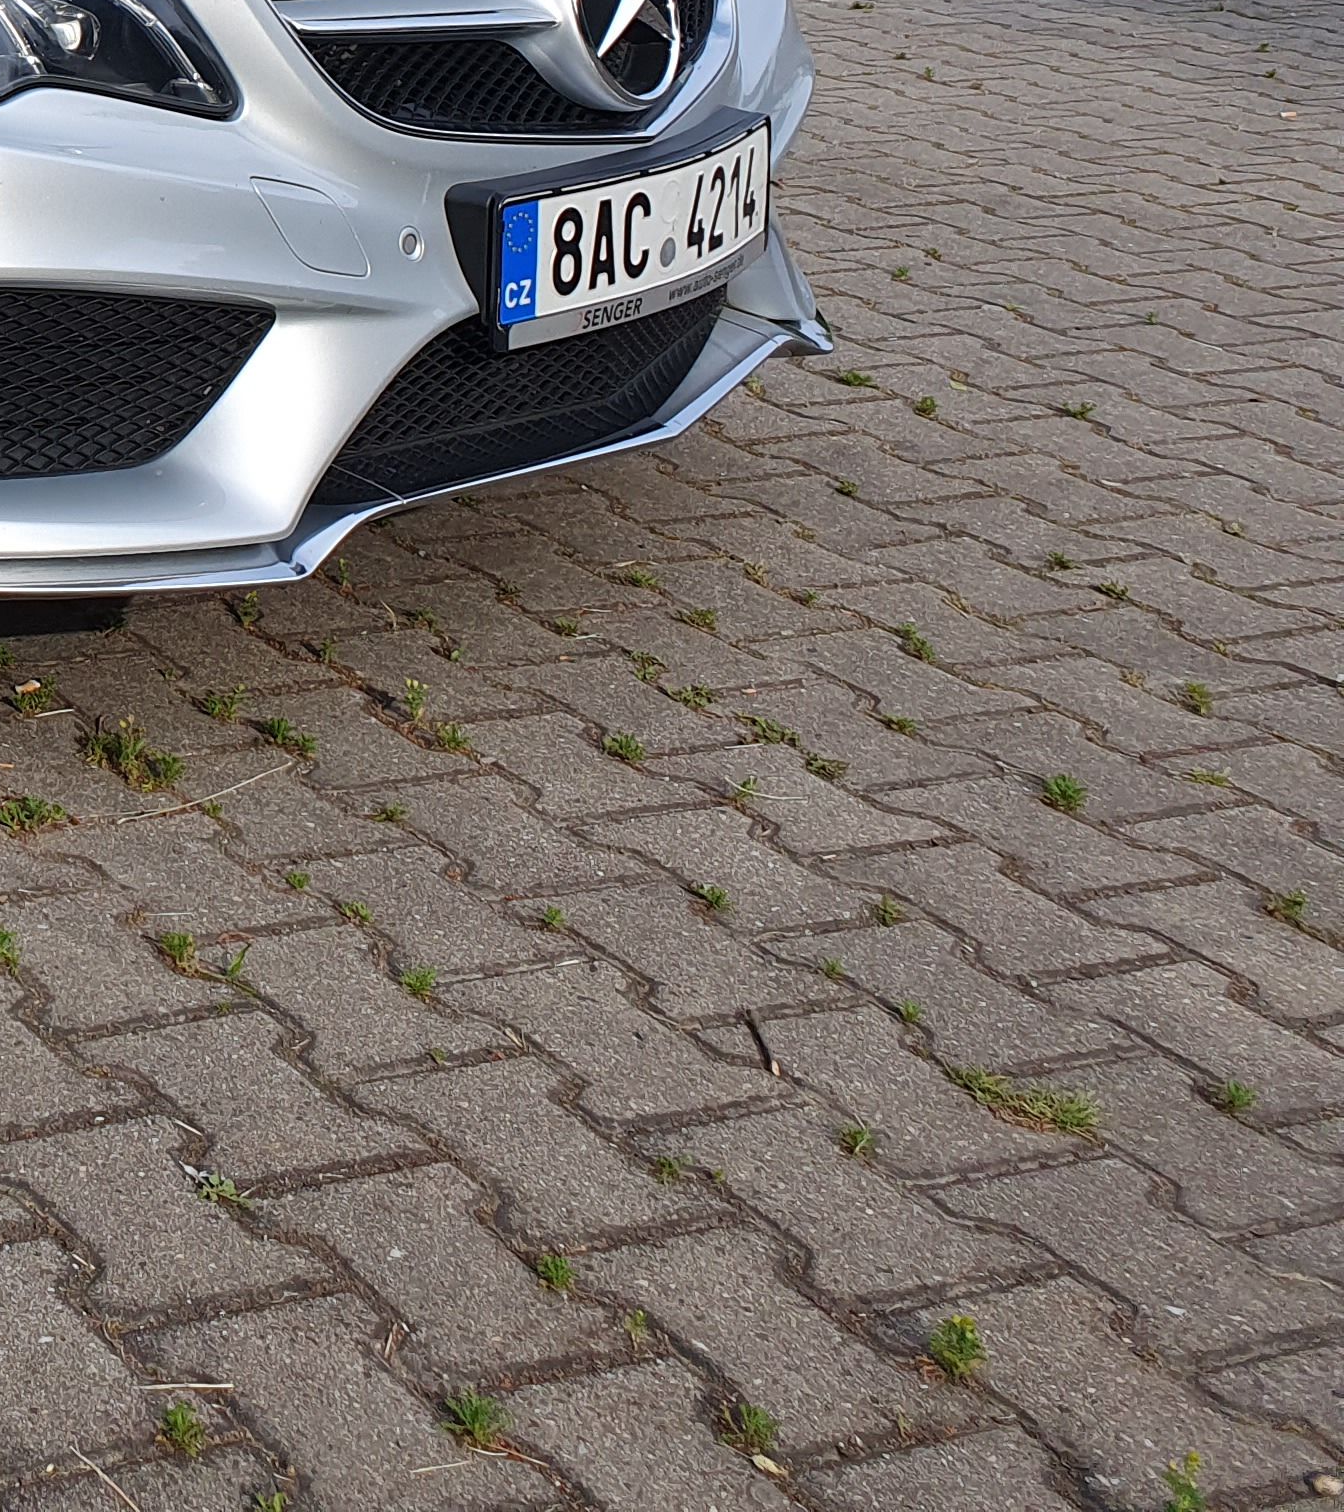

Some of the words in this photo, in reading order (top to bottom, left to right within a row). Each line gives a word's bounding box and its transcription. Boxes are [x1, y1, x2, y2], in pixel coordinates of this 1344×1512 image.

[551, 191, 652, 296] 8AC
[686, 146, 757, 260] 4214
[504, 278, 532, 309] CZ
[582, 297, 643, 330] SENGER
